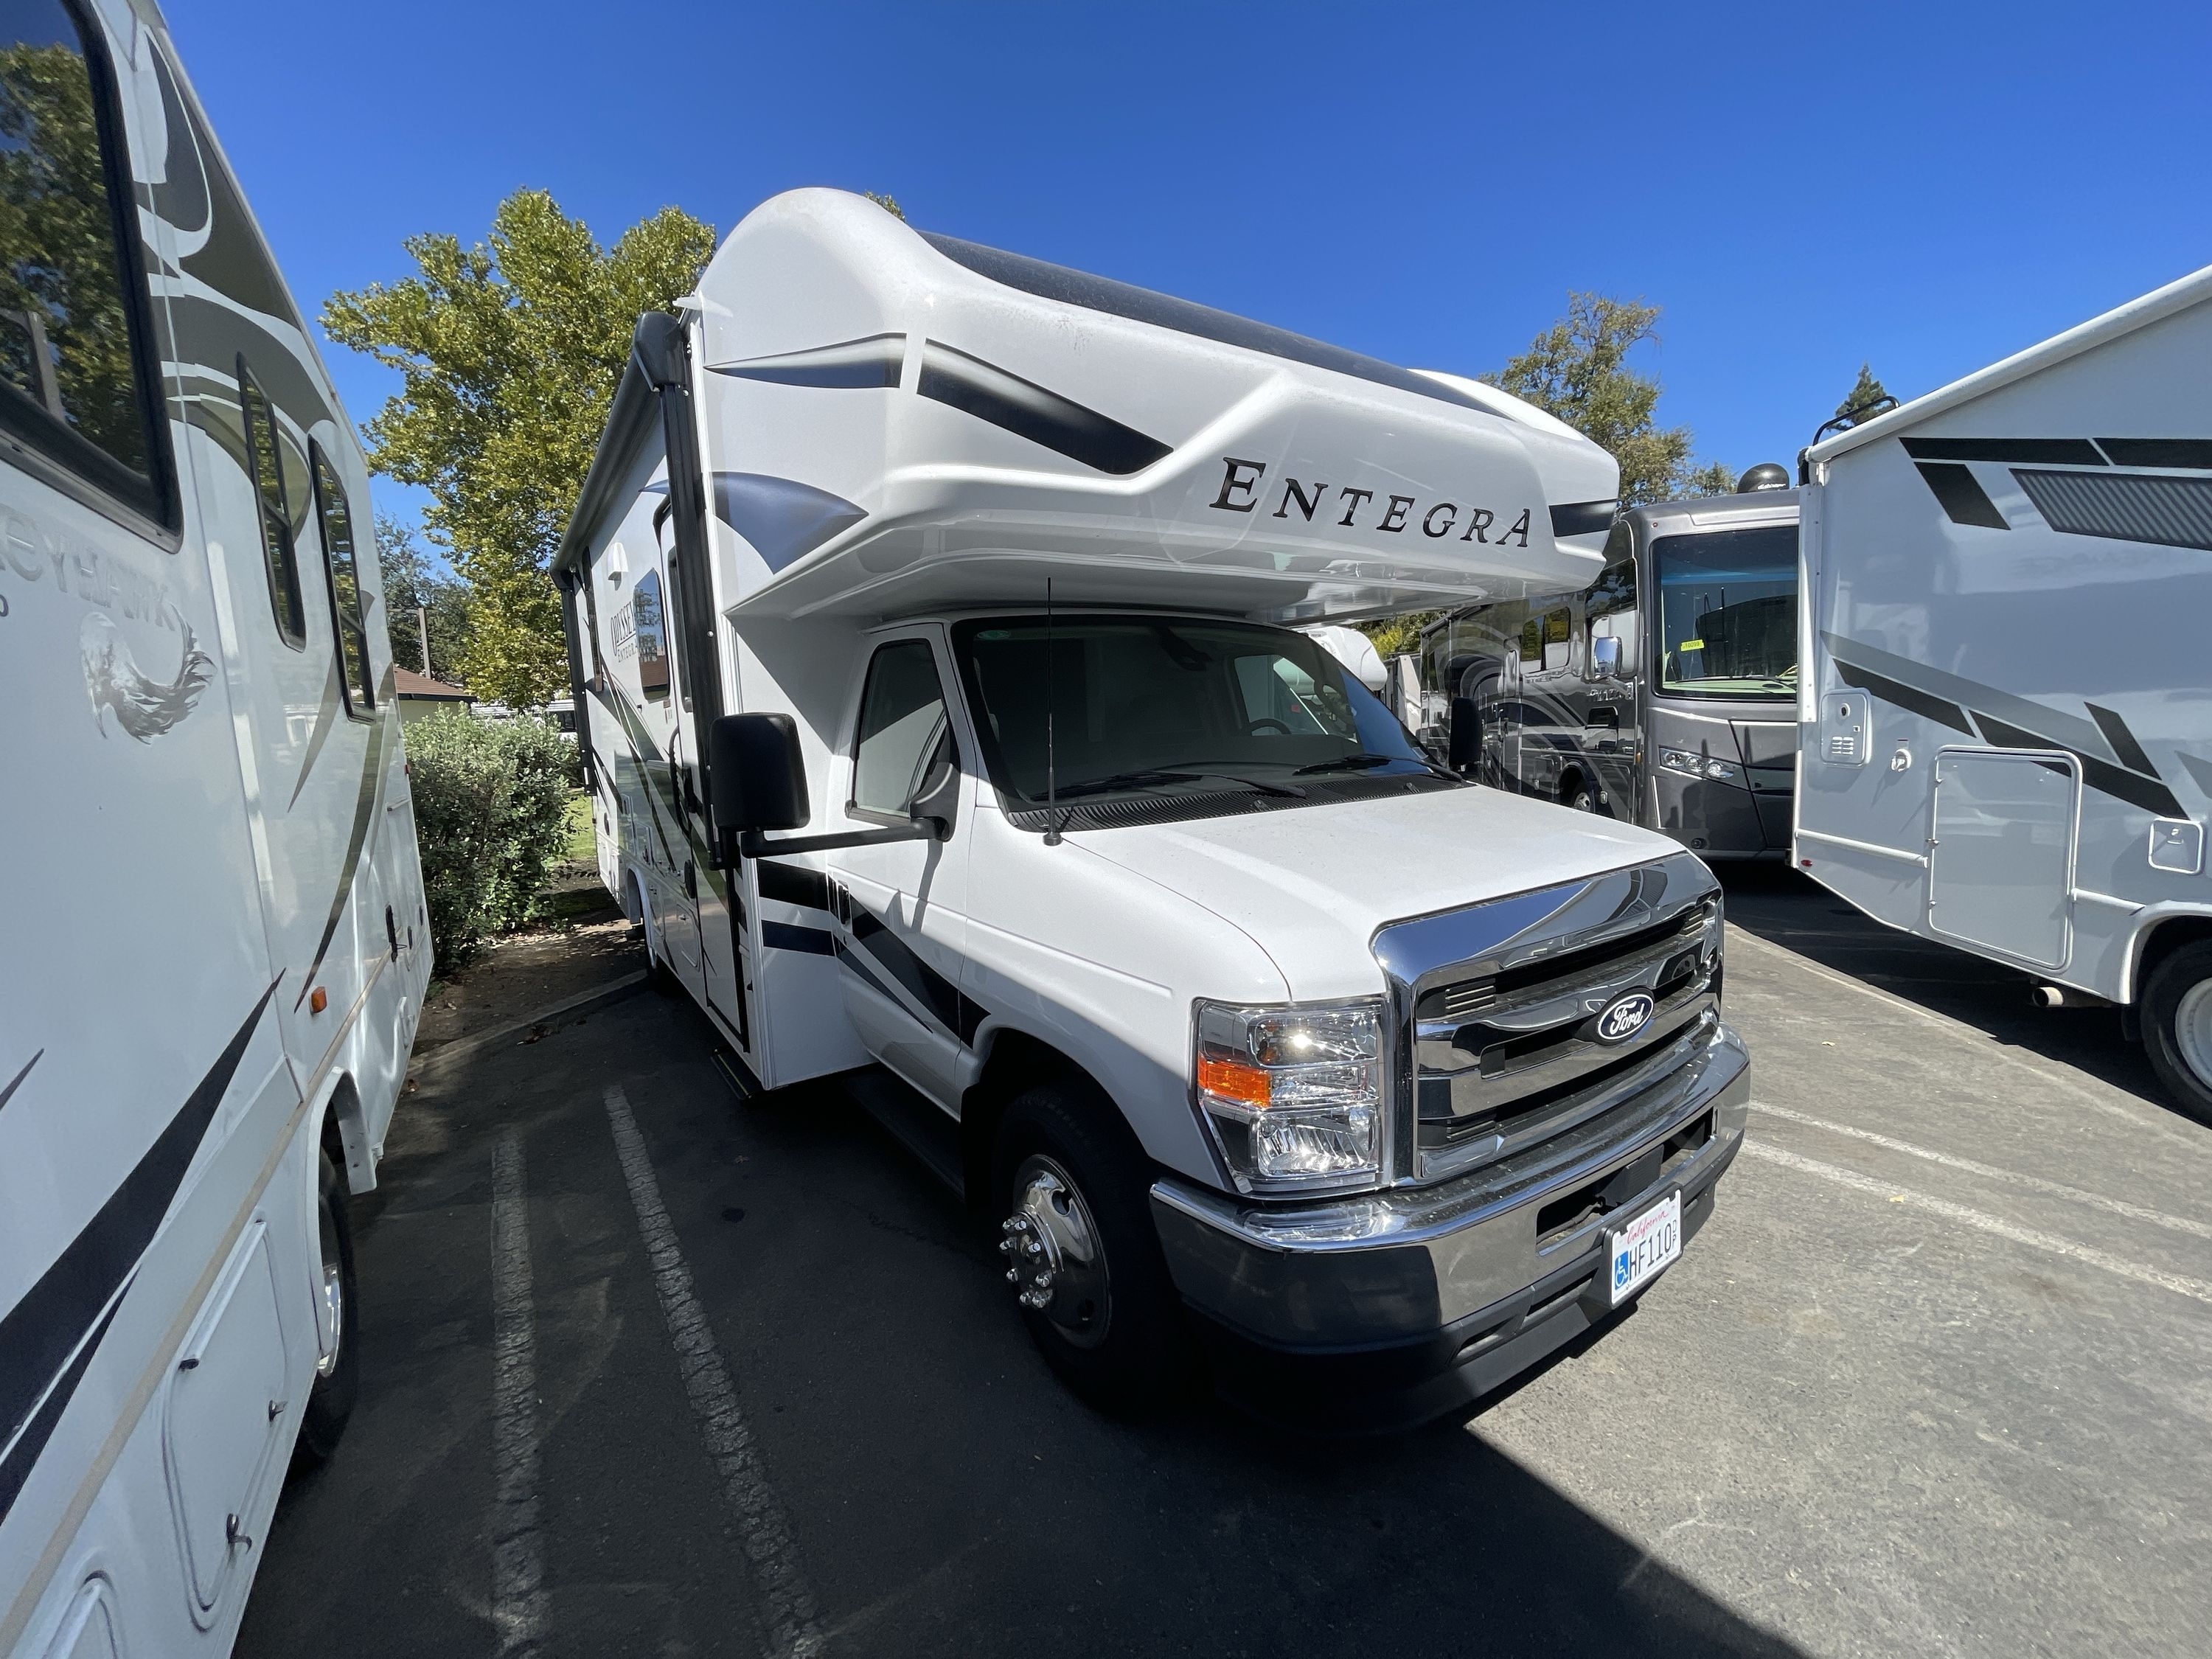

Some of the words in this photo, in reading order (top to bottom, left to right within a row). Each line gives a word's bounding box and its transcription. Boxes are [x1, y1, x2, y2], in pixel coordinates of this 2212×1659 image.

[1209, 457, 1531, 547] ENTEGRA
[1610, 1001, 1644, 1034] Ford
[1627, 1208, 1669, 1244] California
[1630, 1223, 1671, 1281] HF110
